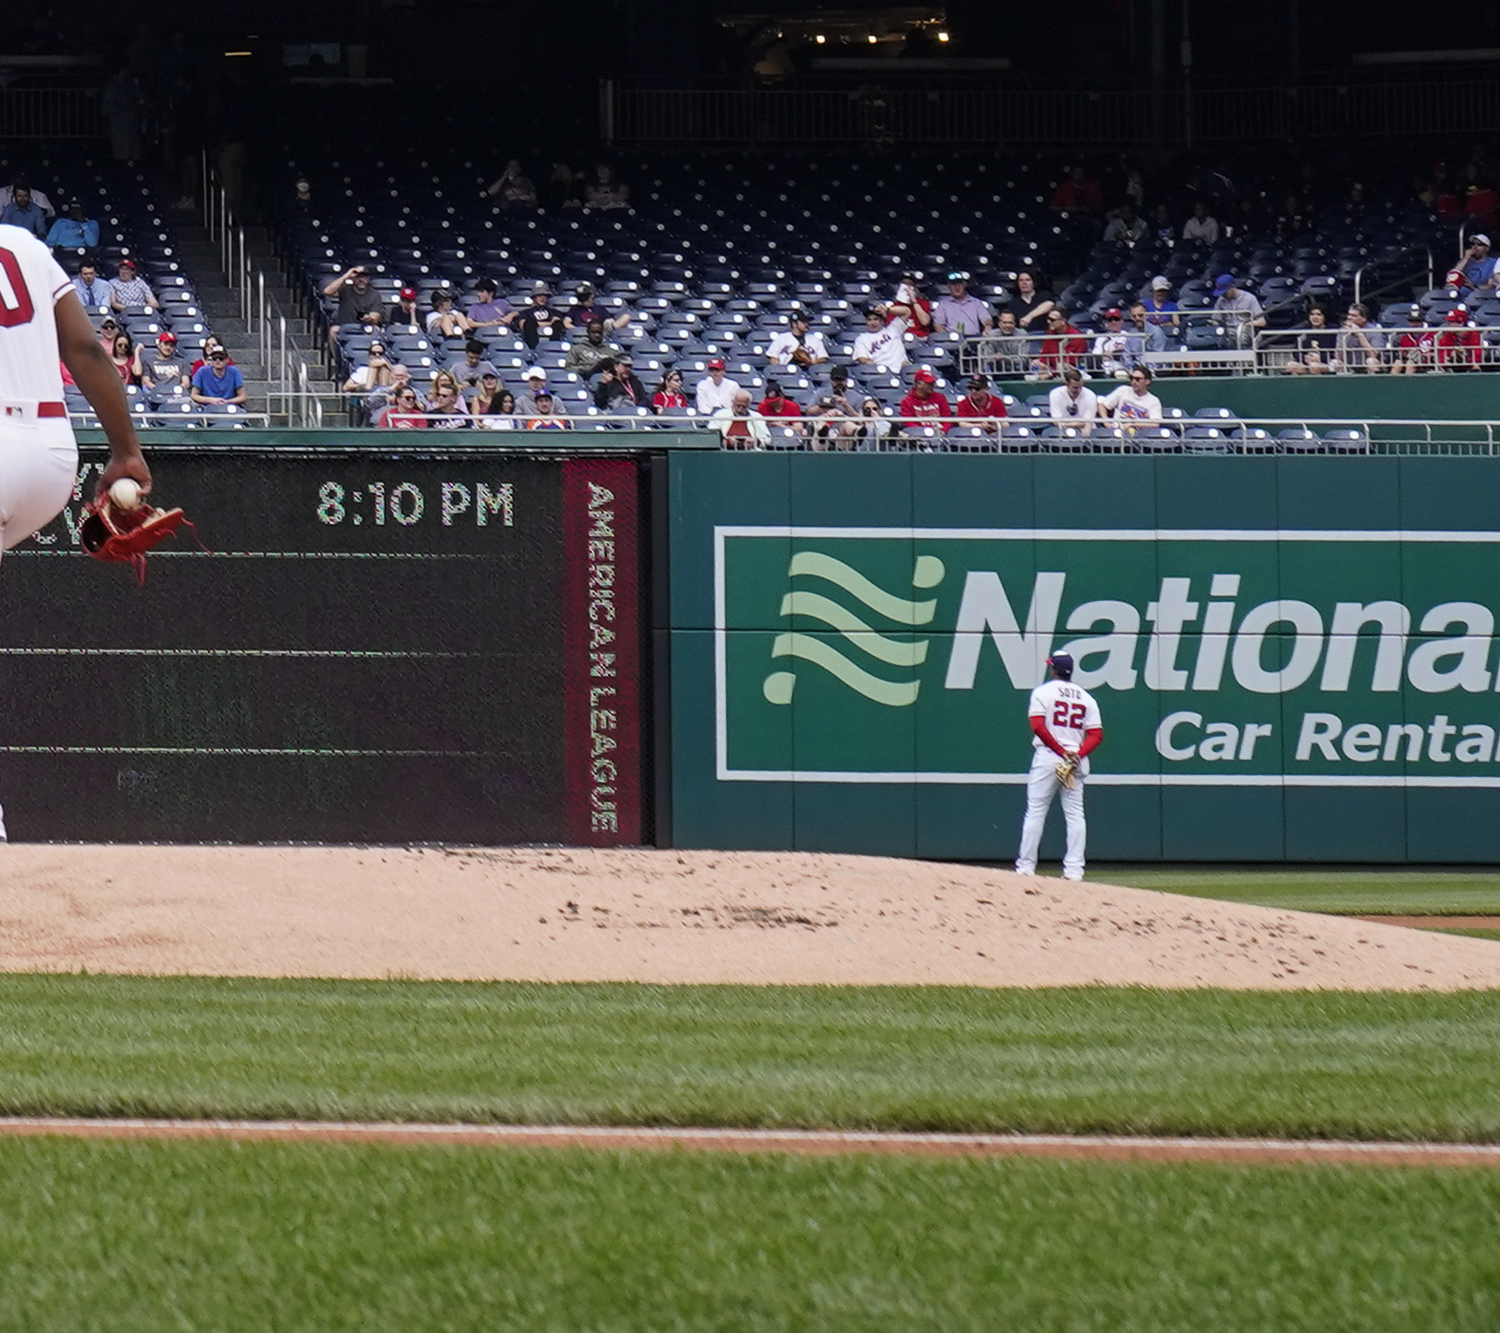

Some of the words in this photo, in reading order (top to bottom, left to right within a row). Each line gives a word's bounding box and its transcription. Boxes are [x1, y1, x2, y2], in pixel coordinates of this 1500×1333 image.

[315, 481, 425, 526] 8:10
[441, 481, 515, 527] PM
[586, 481, 617, 682] AMERICAN
[943, 570, 1500, 694] Nationa
[1053, 701, 1088, 731] 22
[1057, 688, 1082, 701] SOTO
[588, 686, 619, 835] LEAGUE
[1154, 709, 1273, 763] Car
[1294, 711, 1500, 764] Renta
